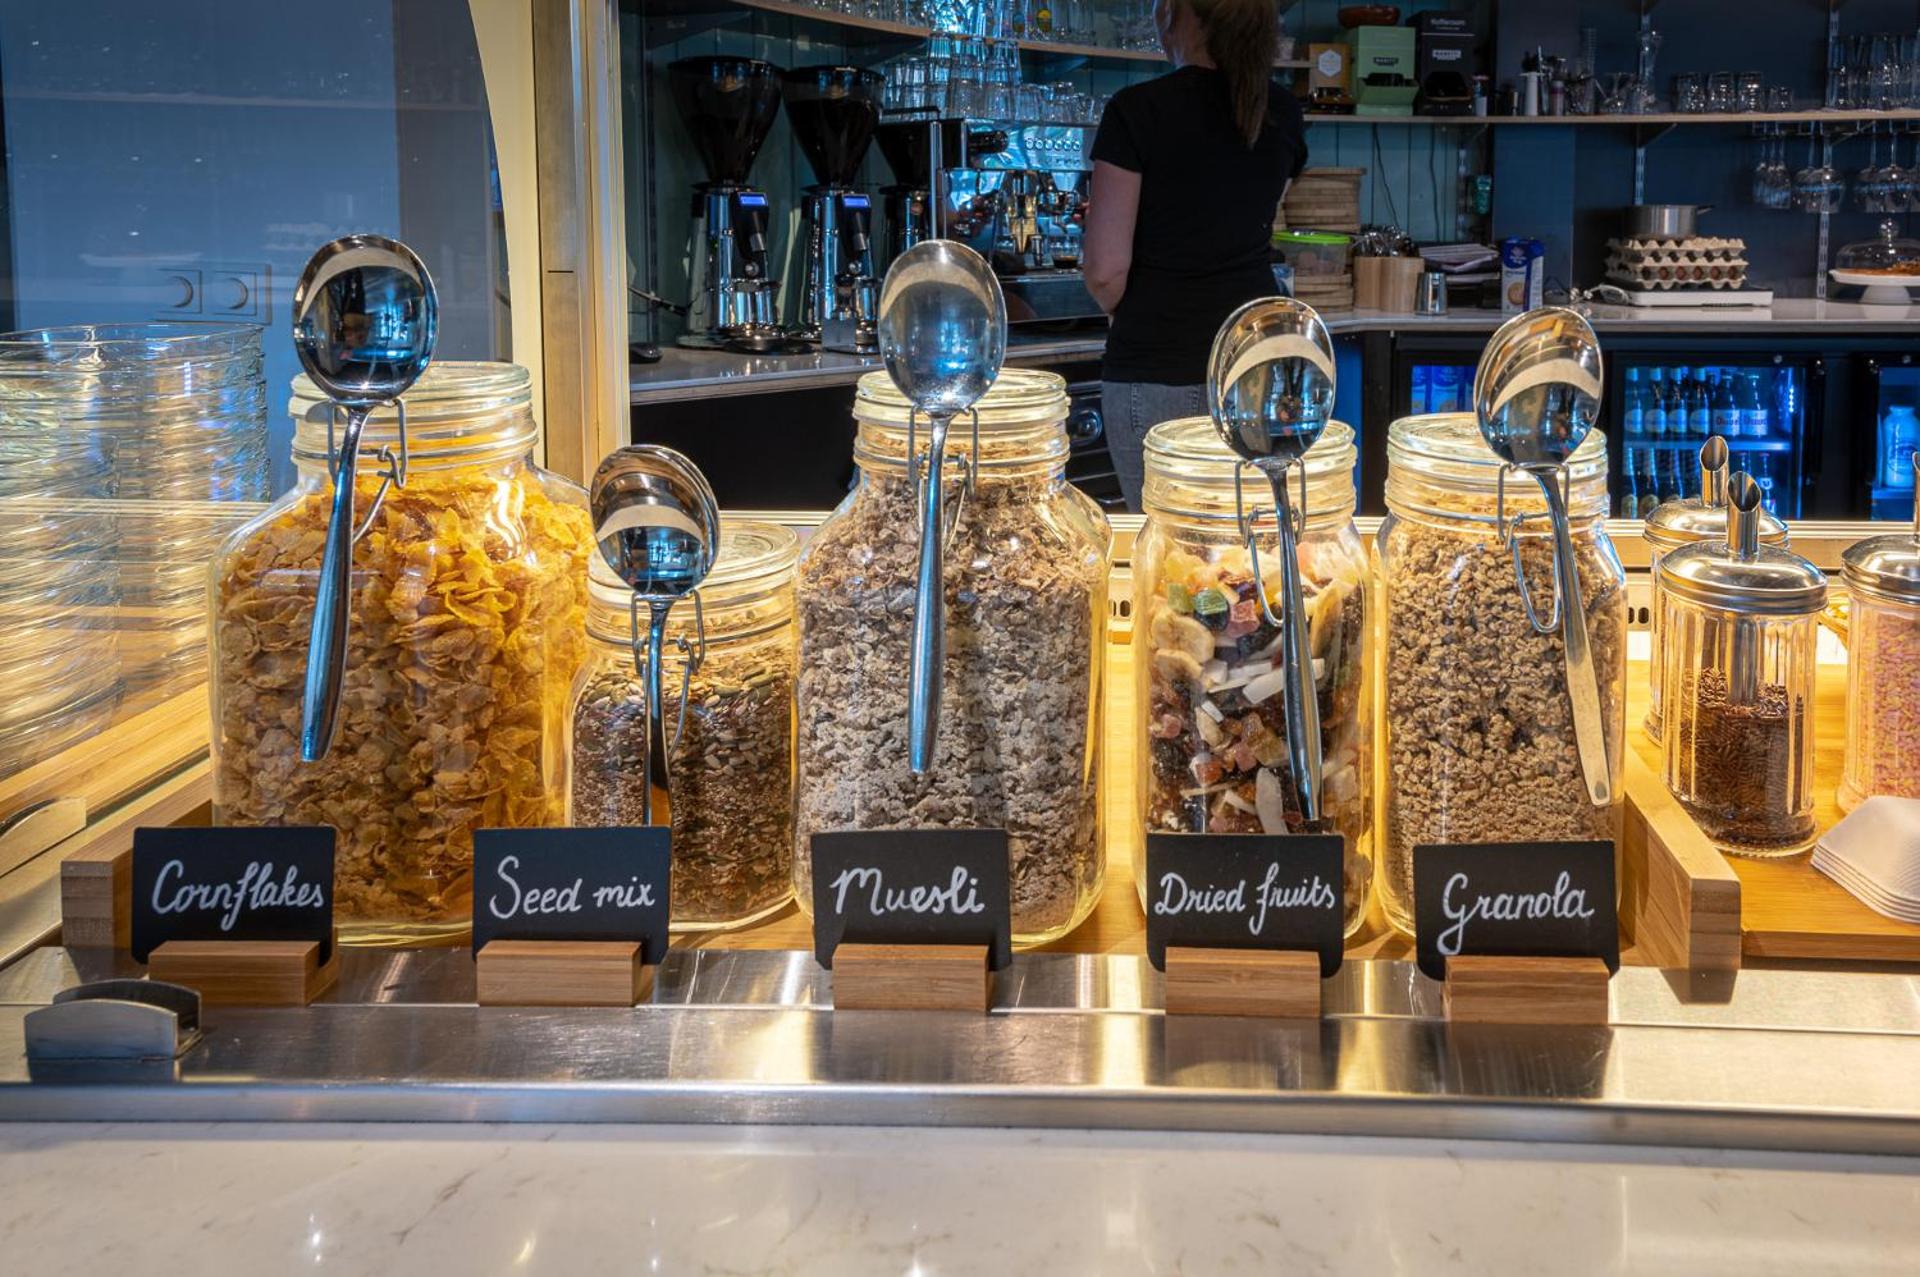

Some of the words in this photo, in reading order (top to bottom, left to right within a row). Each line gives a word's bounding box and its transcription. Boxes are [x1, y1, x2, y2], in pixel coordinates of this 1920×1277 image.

[152, 860, 325, 931] Cornflakes
[490, 855, 582, 919] Seed
[593, 876, 656, 908] mix
[830, 866, 985, 916] Muesli
[1154, 872, 1246, 915] Dried
[1254, 862, 1336, 936] fruits
[1438, 872, 1594, 956] Granola
